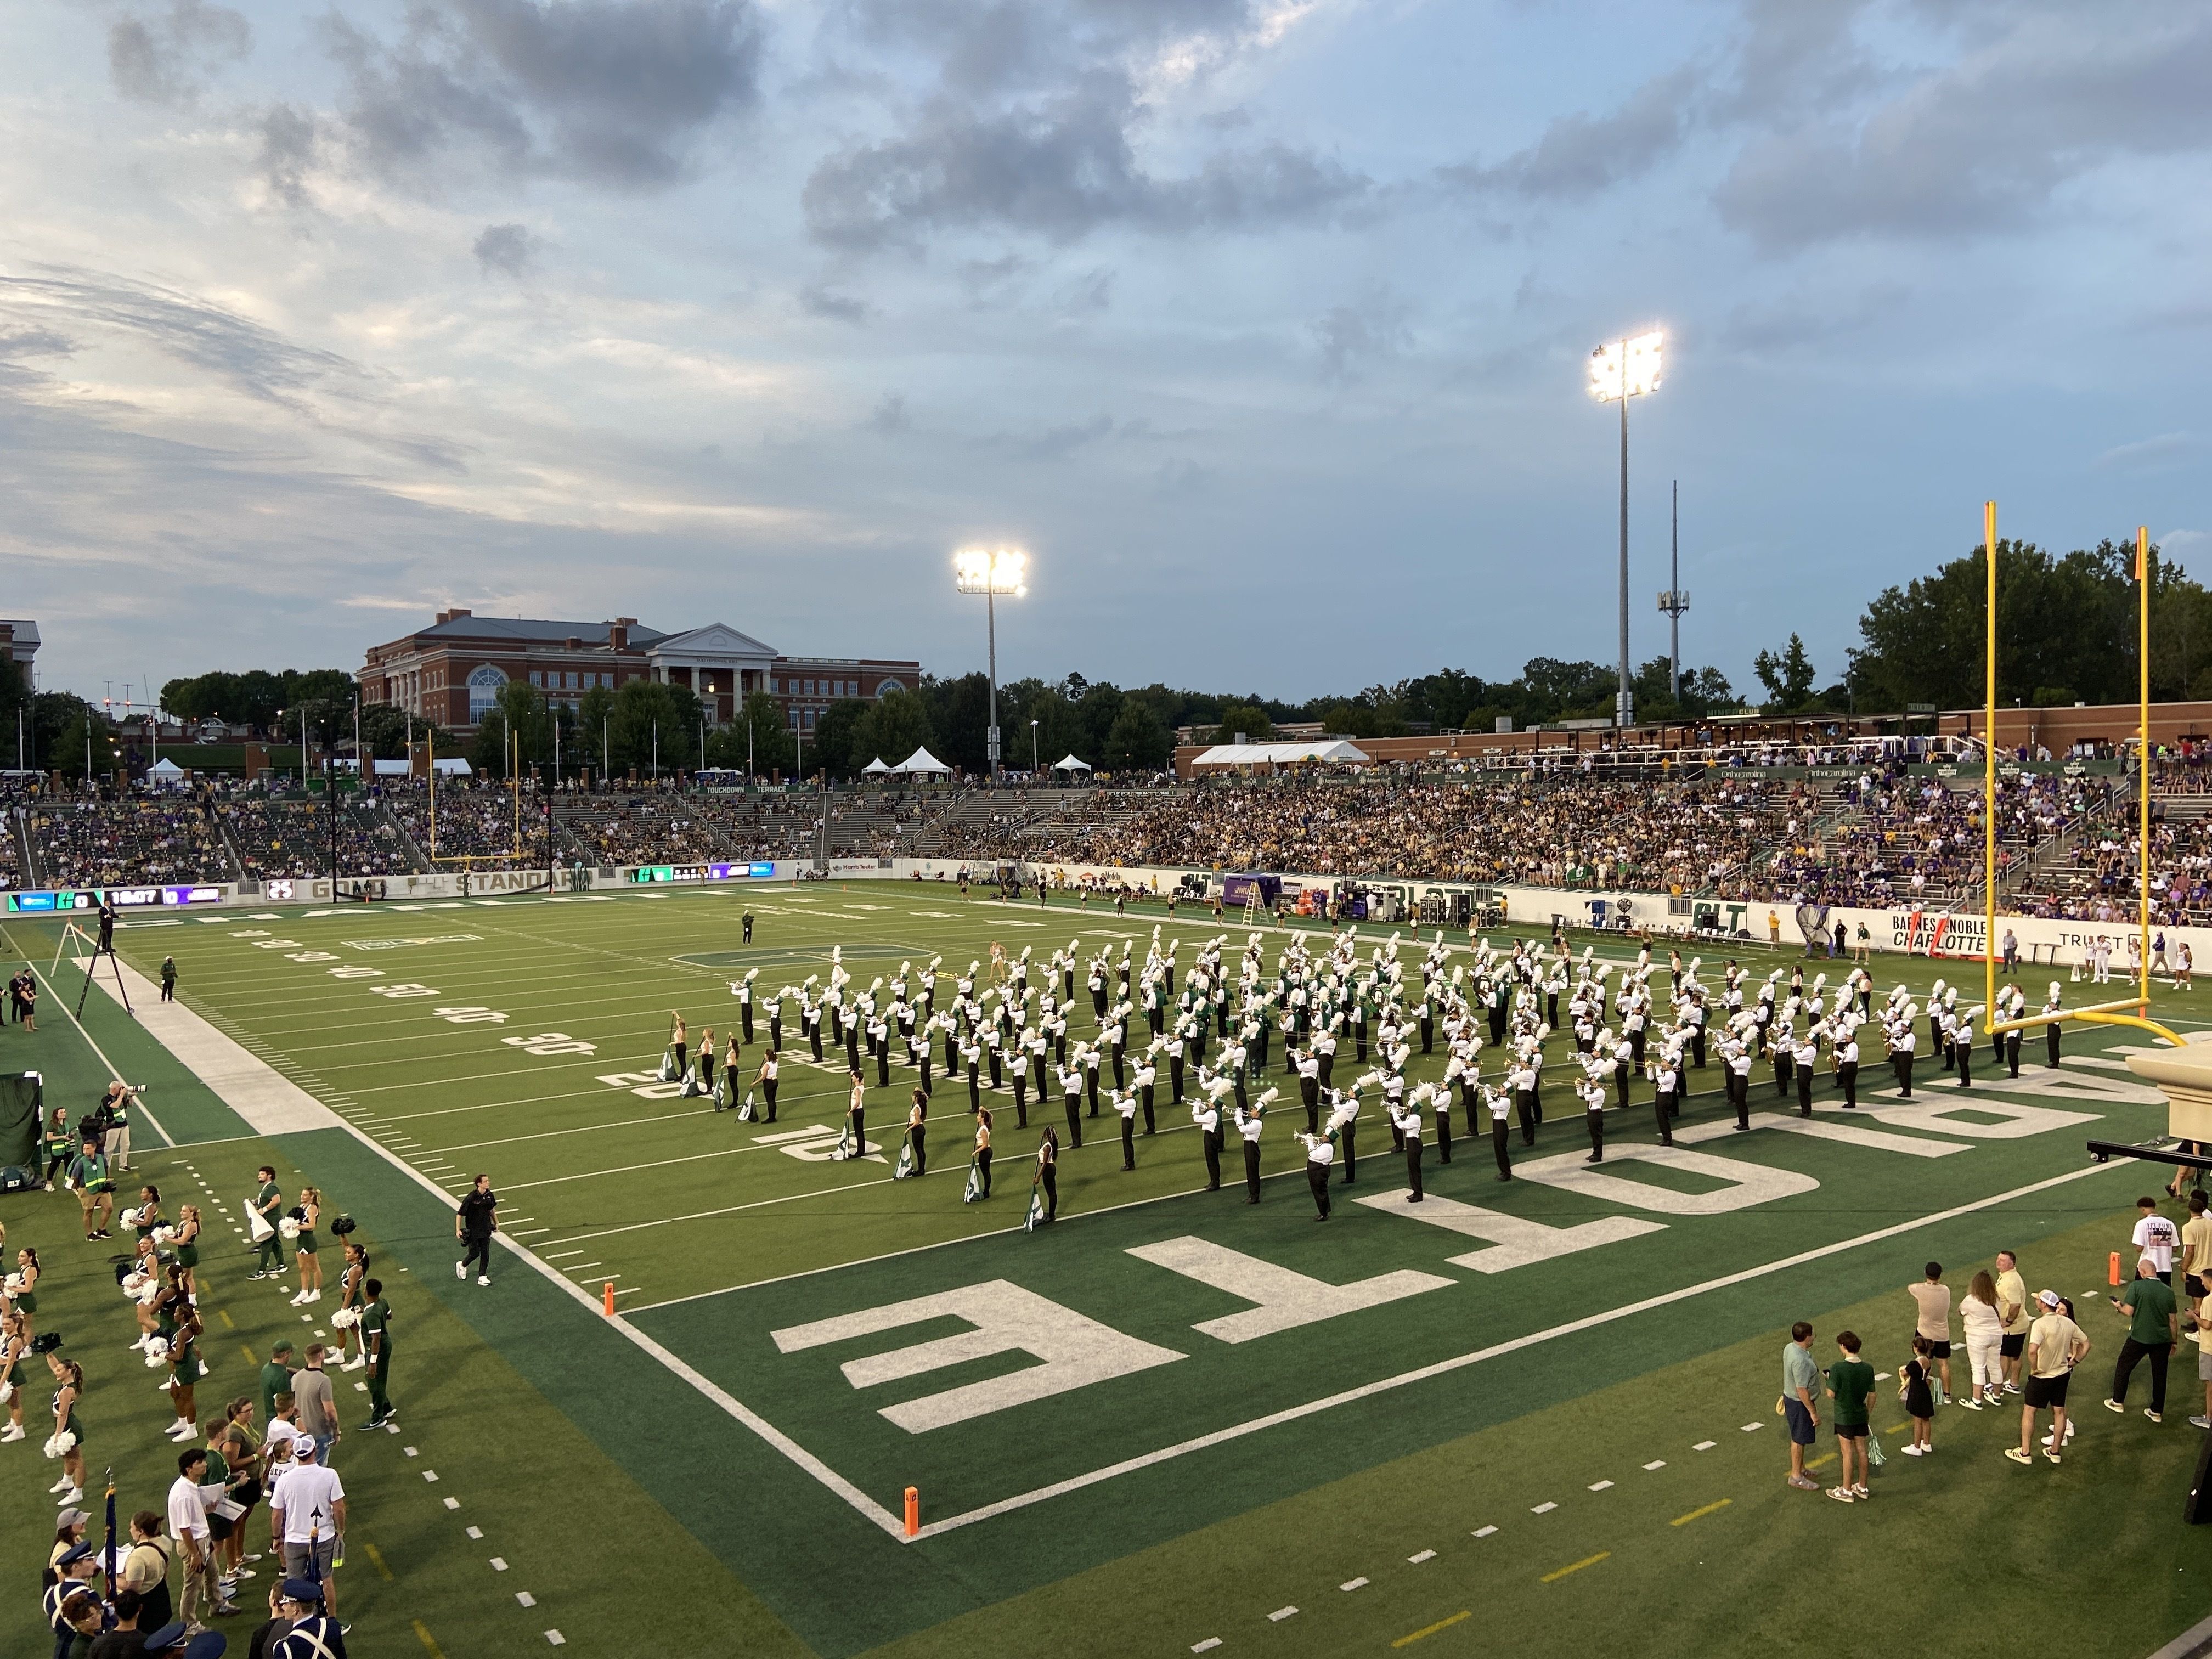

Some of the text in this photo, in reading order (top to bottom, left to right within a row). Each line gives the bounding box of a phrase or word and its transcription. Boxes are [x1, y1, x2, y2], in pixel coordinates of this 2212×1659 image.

[707, 785, 787, 794] TOUCHDOWN TERRACE
[909, 782, 955, 791] STANDARD
[1105, 871, 1121, 881] Modelo
[269, 881, 293, 899] 25
[1949, 919, 1987, 935] NOBLE
[326, 964, 386, 979] 40
[369, 983, 441, 998] 50
[432, 1006, 511, 1024] 40
[500, 1032, 599, 1056] 30
[750, 1124, 883, 1163] 10
